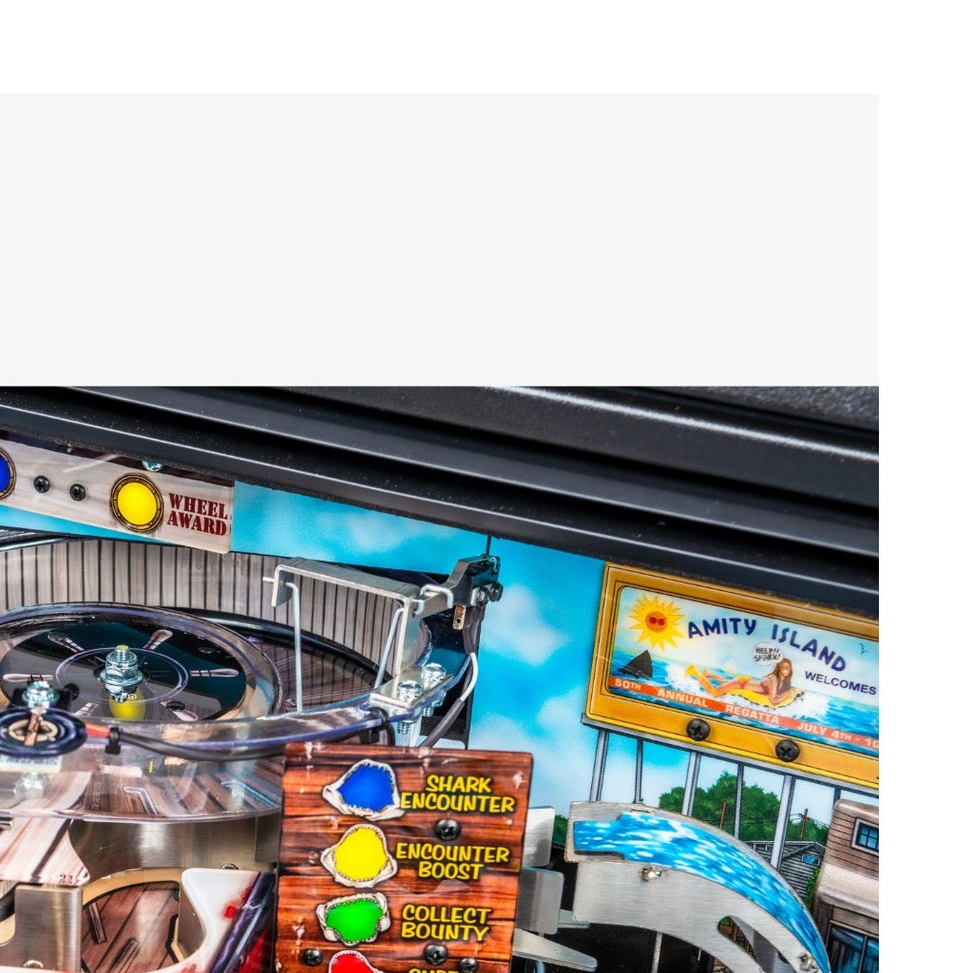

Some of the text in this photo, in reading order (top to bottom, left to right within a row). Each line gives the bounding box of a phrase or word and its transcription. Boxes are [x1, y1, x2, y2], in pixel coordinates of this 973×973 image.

[167, 493, 228, 520] WHEEL
[167, 510, 227, 537] AWARD
[687, 617, 847, 673] AMITY ISLAND
[804, 670, 878, 696] WELCOMES
[614, 678, 642, 691] 50TH
[657, 688, 709, 708] ANNUAL
[725, 704, 780, 725] REGATTA
[796, 721, 827, 737] JULY
[831, 728, 852, 742] 4TH
[425, 774, 492, 793] SHARK
[400, 792, 516, 813] ENCOUNTER
[396, 842, 510, 863] ENCOUNTER
[418, 860, 484, 881] BOOST
[401, 904, 492, 924] COLLECT
[401, 923, 490, 942] BOUNTY
